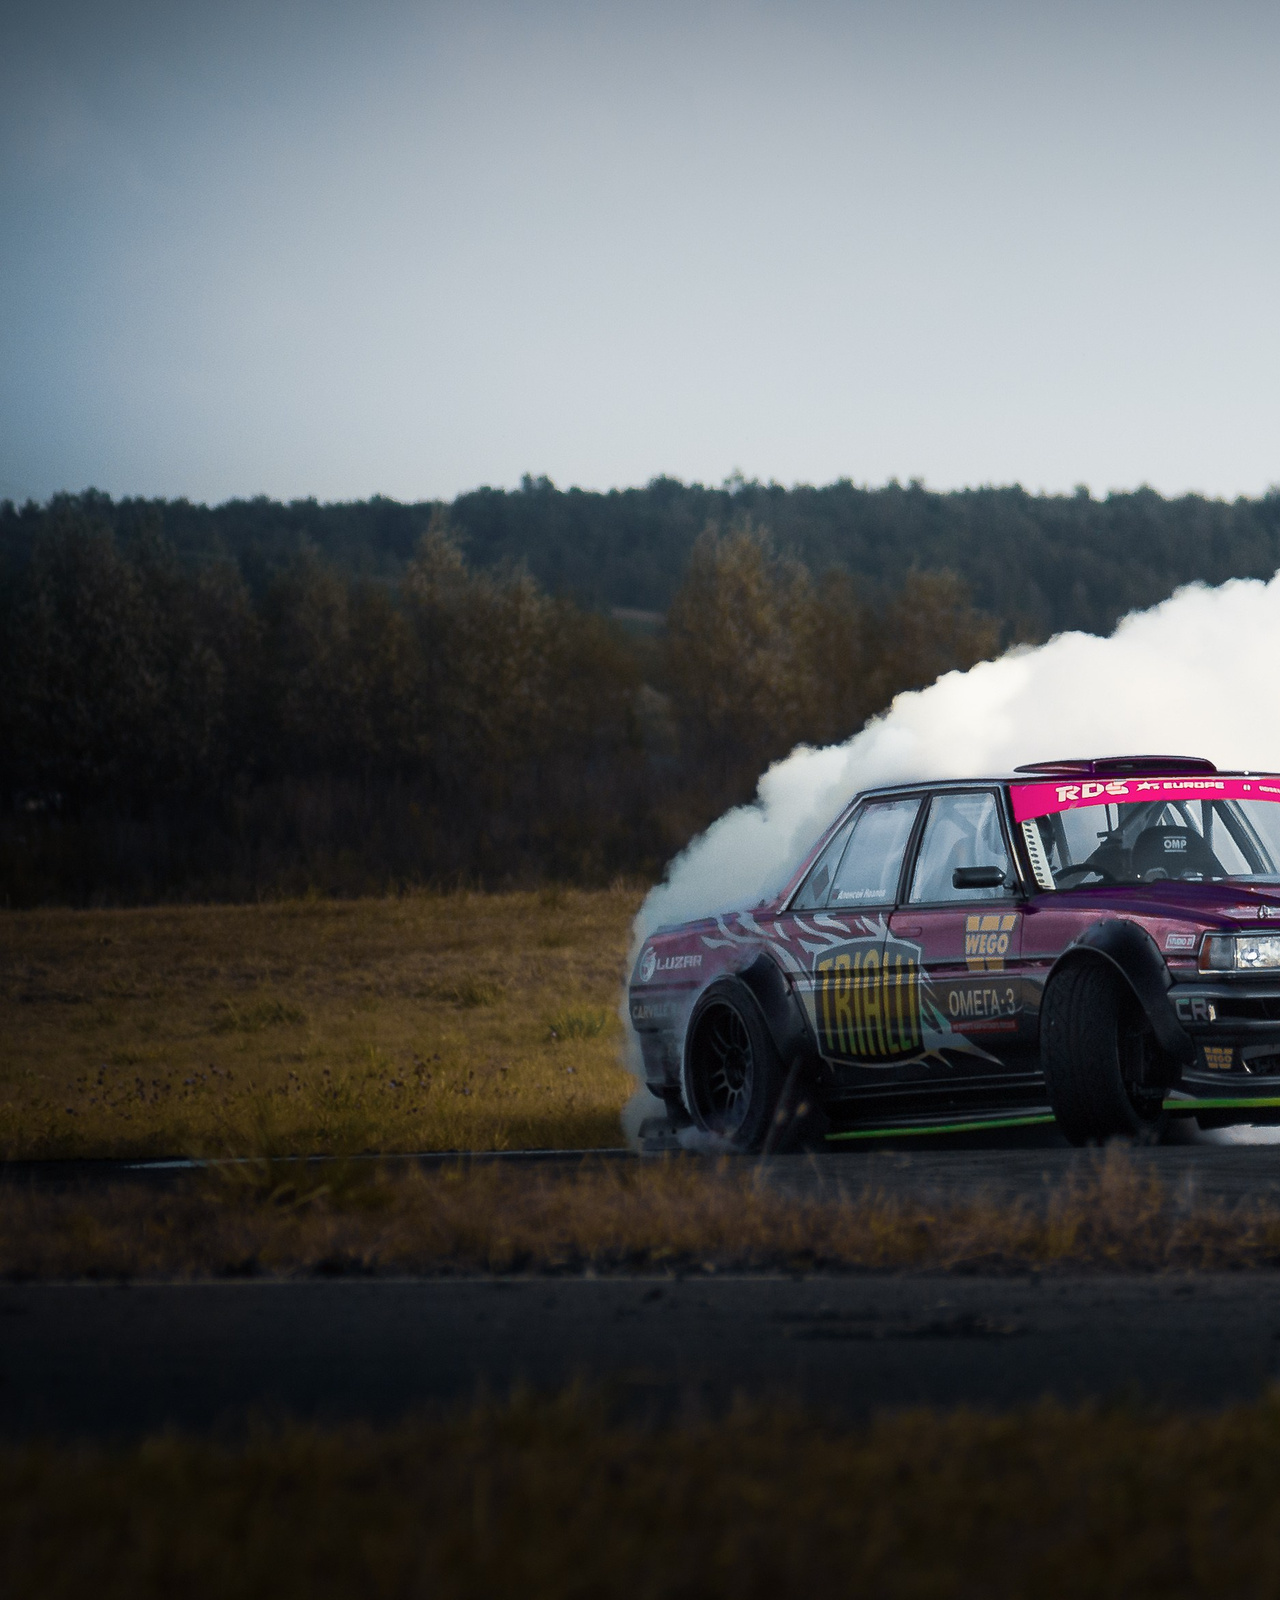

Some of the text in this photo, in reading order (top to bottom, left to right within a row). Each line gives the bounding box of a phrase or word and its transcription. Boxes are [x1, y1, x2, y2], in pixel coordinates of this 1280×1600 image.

[1055, 781, 1225, 802] RDS EUROPE
[1163, 839, 1188, 850] OMP
[965, 932, 1009, 955] WEGO
[656, 954, 703, 971] LUZAR
[818, 948, 919, 1056] TRIALLI
